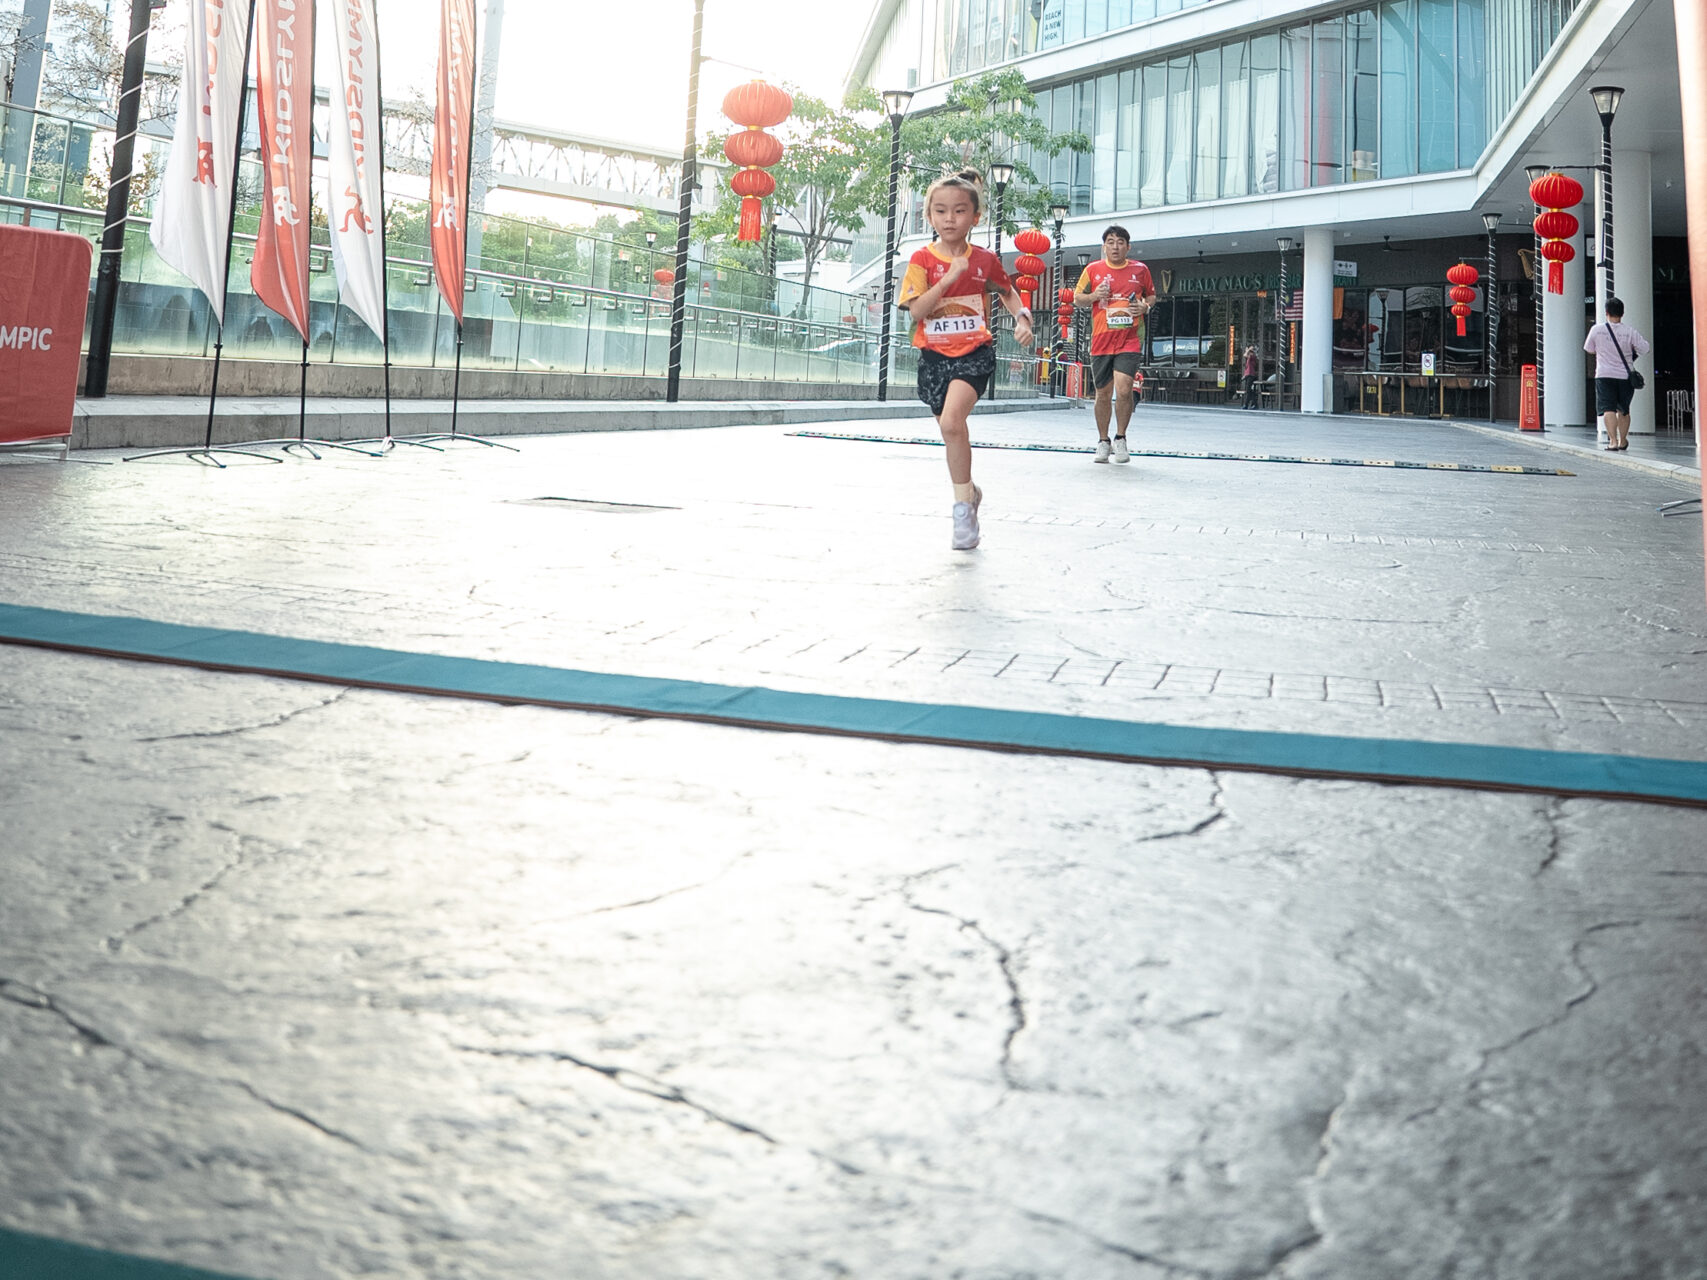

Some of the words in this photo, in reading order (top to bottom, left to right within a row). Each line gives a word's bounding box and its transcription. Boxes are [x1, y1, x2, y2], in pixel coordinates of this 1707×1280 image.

[1179, 278, 1218, 292] HEALY
[1224, 274, 1262, 291] MAC'S
[934, 321, 949, 332] AF
[953, 319, 976, 331] 113
